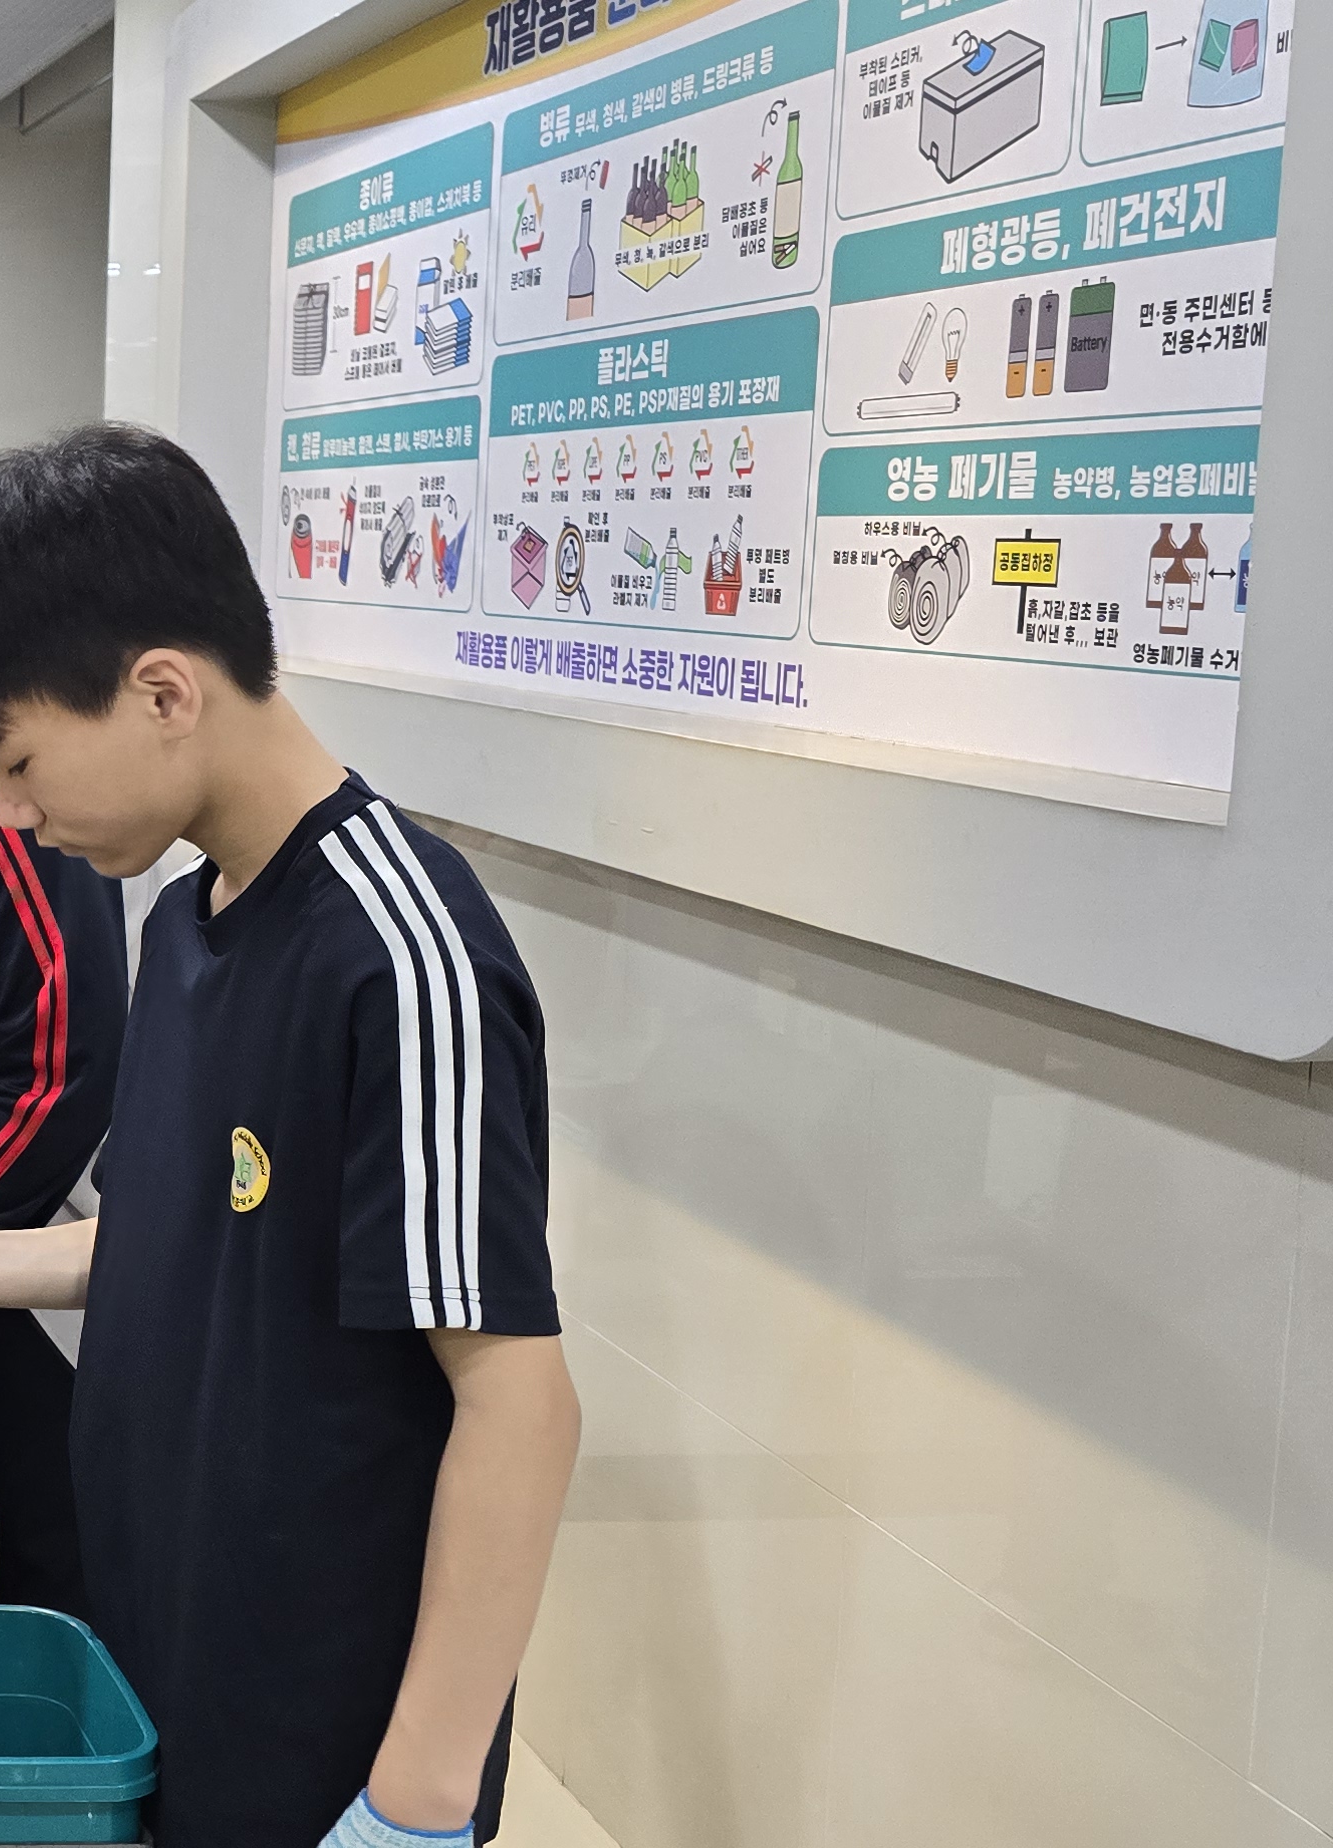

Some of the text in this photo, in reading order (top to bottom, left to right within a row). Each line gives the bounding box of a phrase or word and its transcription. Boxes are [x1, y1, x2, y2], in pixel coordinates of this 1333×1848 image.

[859, 45, 924, 80] 부착된 스티커,
[540, 46, 774, 148] 병류 무색, 청색, 갈색의 병류, 드링크류 등
[869, 69, 911, 98] 테이프 등
[863, 90, 915, 121] 이물질 제거
[360, 171, 394, 211] 종이류
[473, 180, 482, 202] 등
[759, 197, 768, 214] 등
[939, 176, 1228, 276] 폐형광등, 폐건전지
[659, 237, 691, 259] 갈색으로
[693, 233, 710, 251] 분리
[739, 238, 766, 258] 싫어요
[1139, 299, 1178, 329] 면·동
[1184, 290, 1255, 323] 주민센터
[1070, 334, 1109, 355] Battery
[1162, 321, 1268, 357] 전용수거함에
[597, 339, 669, 386] 플라스틱
[511, 375, 781, 427] PET, PVC, PP, PS, PE, PSP재질의 용기 포장재
[446, 426, 461, 447] 용기
[463, 425, 473, 446] 등
[887, 456, 939, 503] 영농
[948, 451, 1038, 501] 폐기물
[1053, 467, 1121, 501] 농약병,
[864, 521, 900, 537] 하우스용
[998, 551, 1054, 573] 공동집하장
[748, 587, 782, 605] 분리배출
[1167, 596, 1185, 612] 농약
[1096, 602, 1120, 624] 등을
[1026, 623, 1060, 645] 털어낸
[1093, 627, 1119, 649] 보관
[455, 631, 809, 709] 재활용품 이렇게 배출하면 소중한 자원이 됩니다.
[1132, 642, 1241, 672] 영농폐기물 수거
